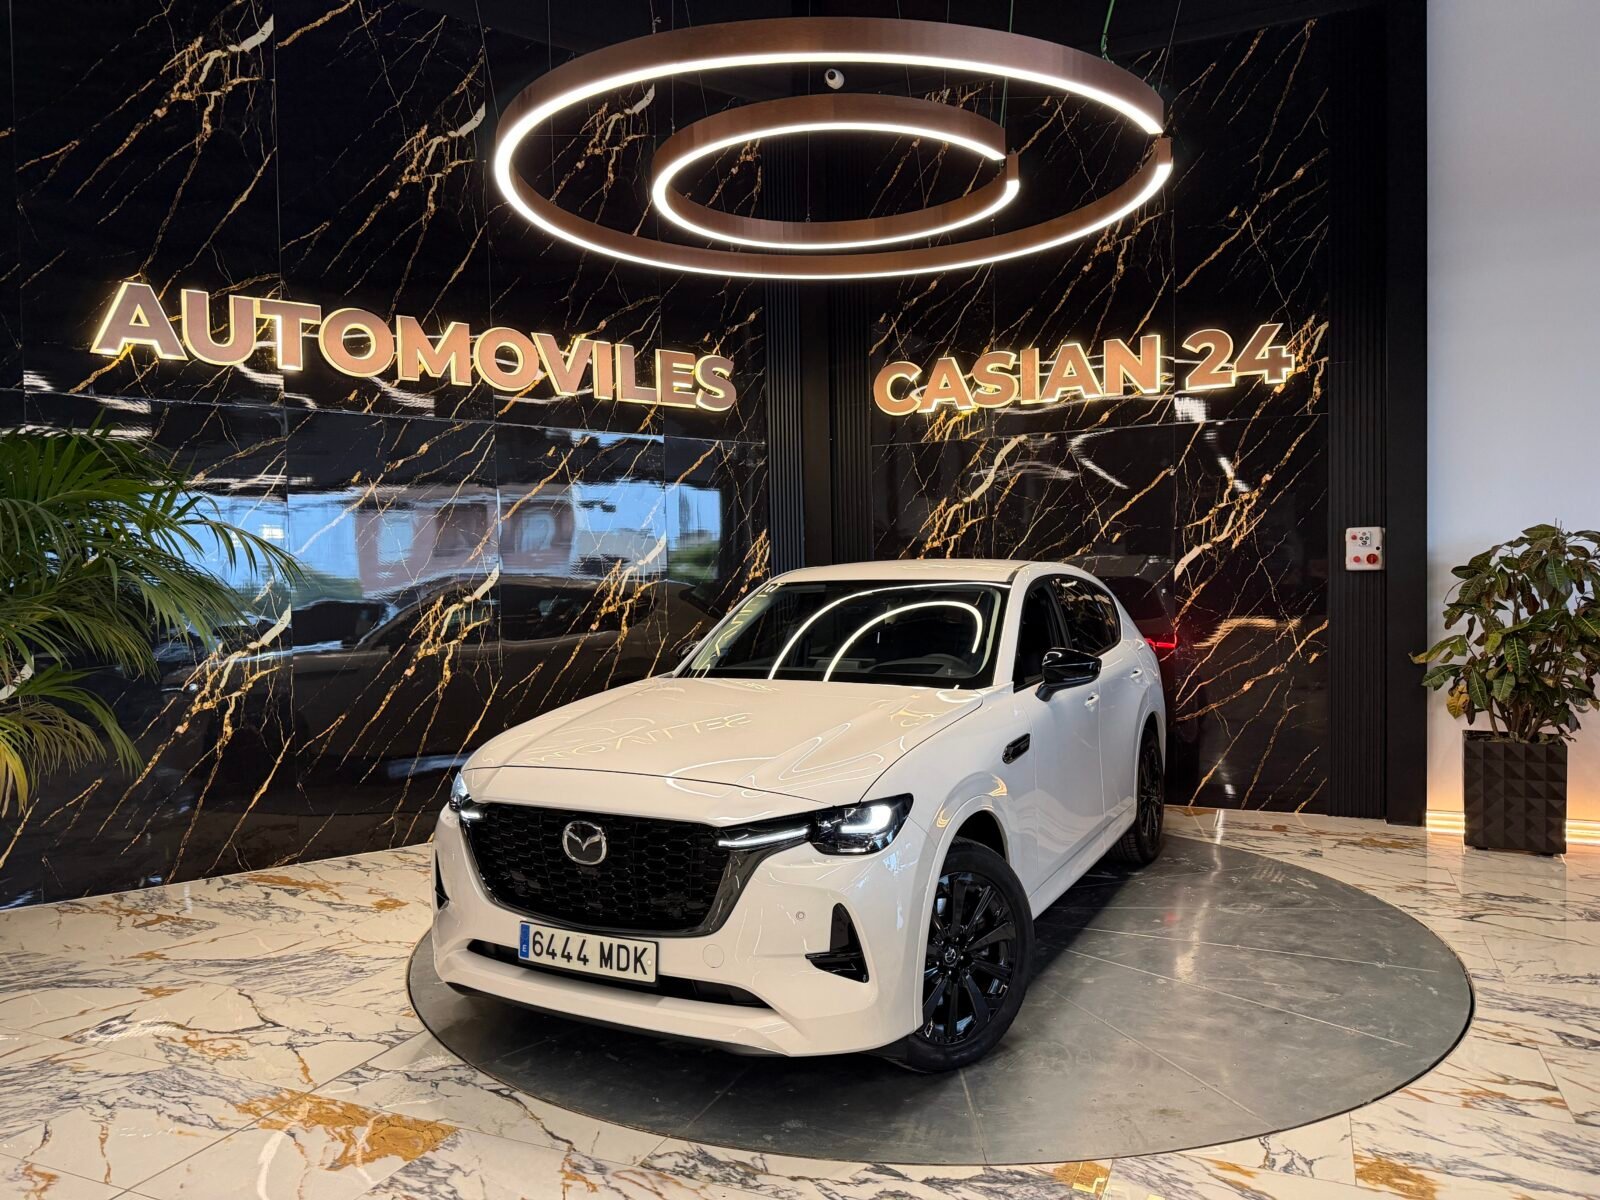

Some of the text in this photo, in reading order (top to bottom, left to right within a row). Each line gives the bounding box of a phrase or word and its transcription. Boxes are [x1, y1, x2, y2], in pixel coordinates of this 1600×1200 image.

[90, 281, 737, 412] AUTOMOVILES
[872, 322, 1296, 416] CASIAN 24
[532, 930, 648, 975] 6444 MDK
